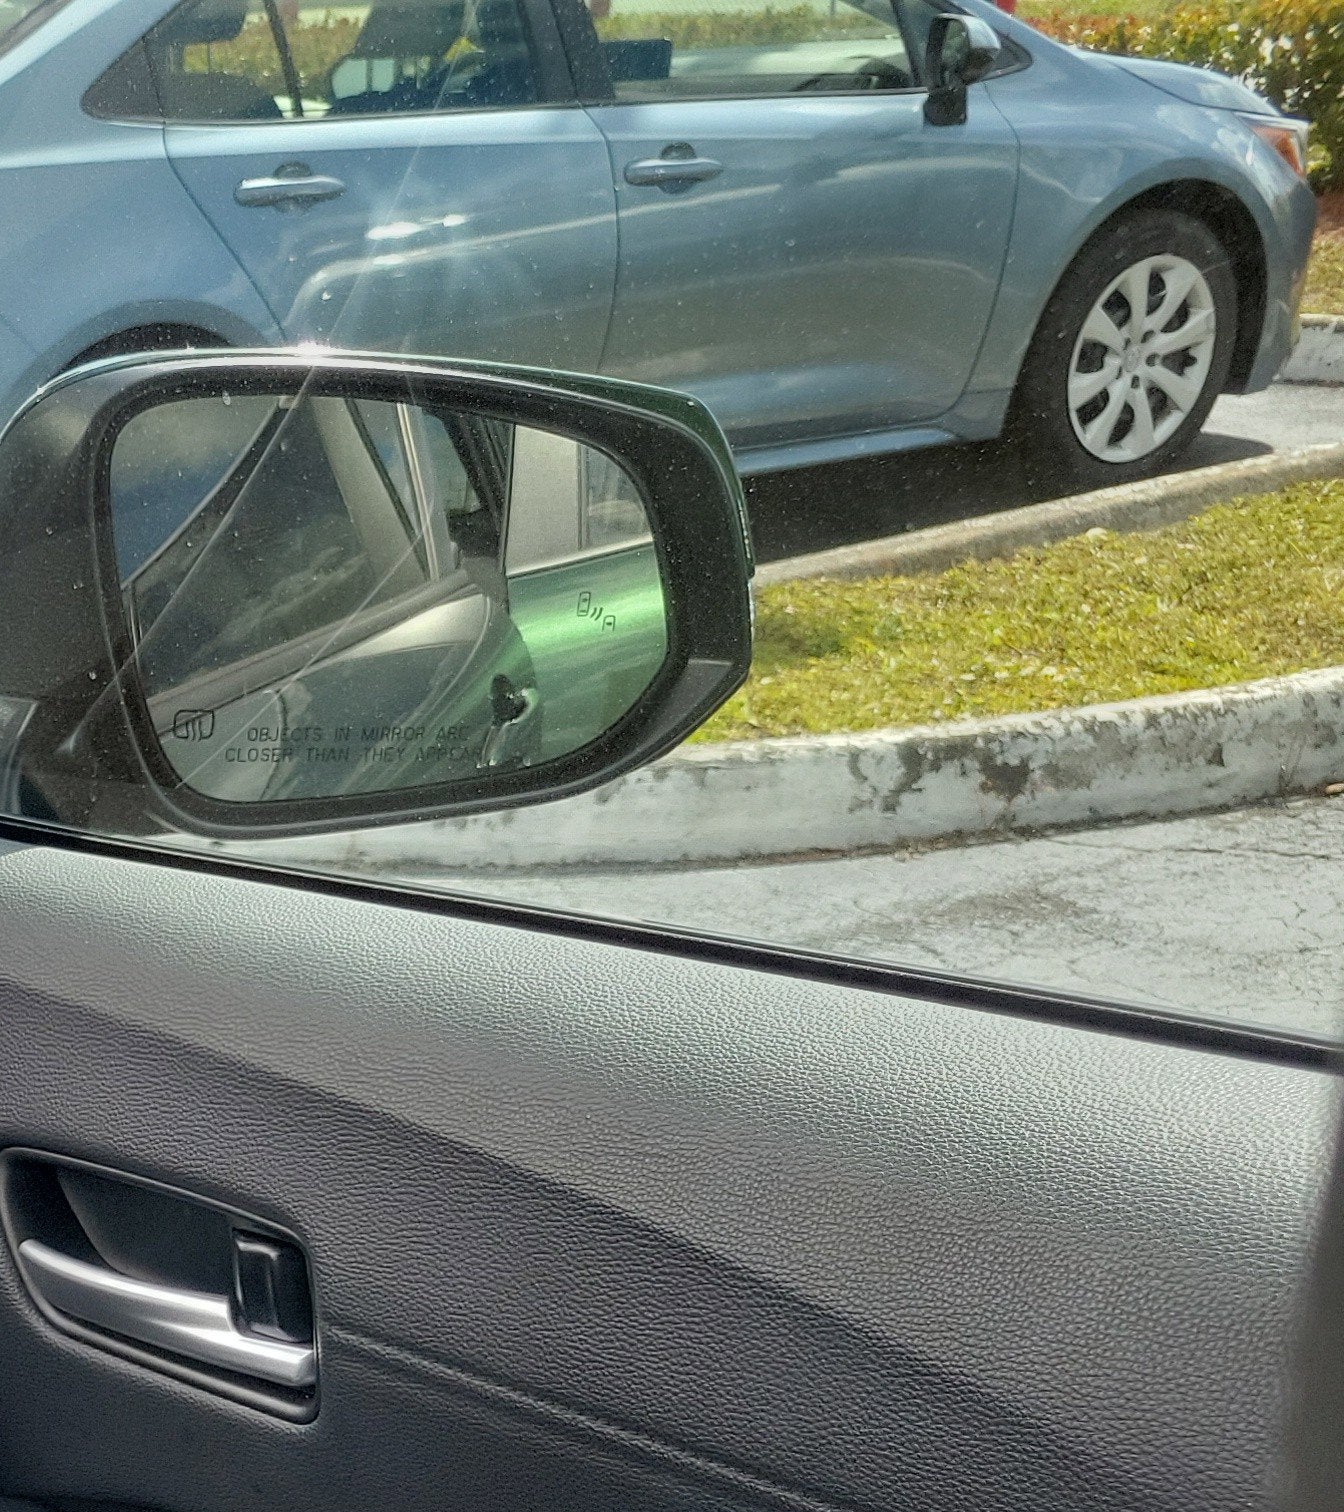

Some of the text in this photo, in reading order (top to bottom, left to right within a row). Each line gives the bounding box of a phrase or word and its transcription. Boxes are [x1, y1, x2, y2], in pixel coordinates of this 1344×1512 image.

[247, 726, 322, 742] OBJECTS
[334, 727, 349, 741] IN
[361, 726, 424, 741] MIRROR
[225, 747, 292, 763] CLOSER
[306, 746, 349, 762] THAN
[363, 746, 405, 762] THEY
